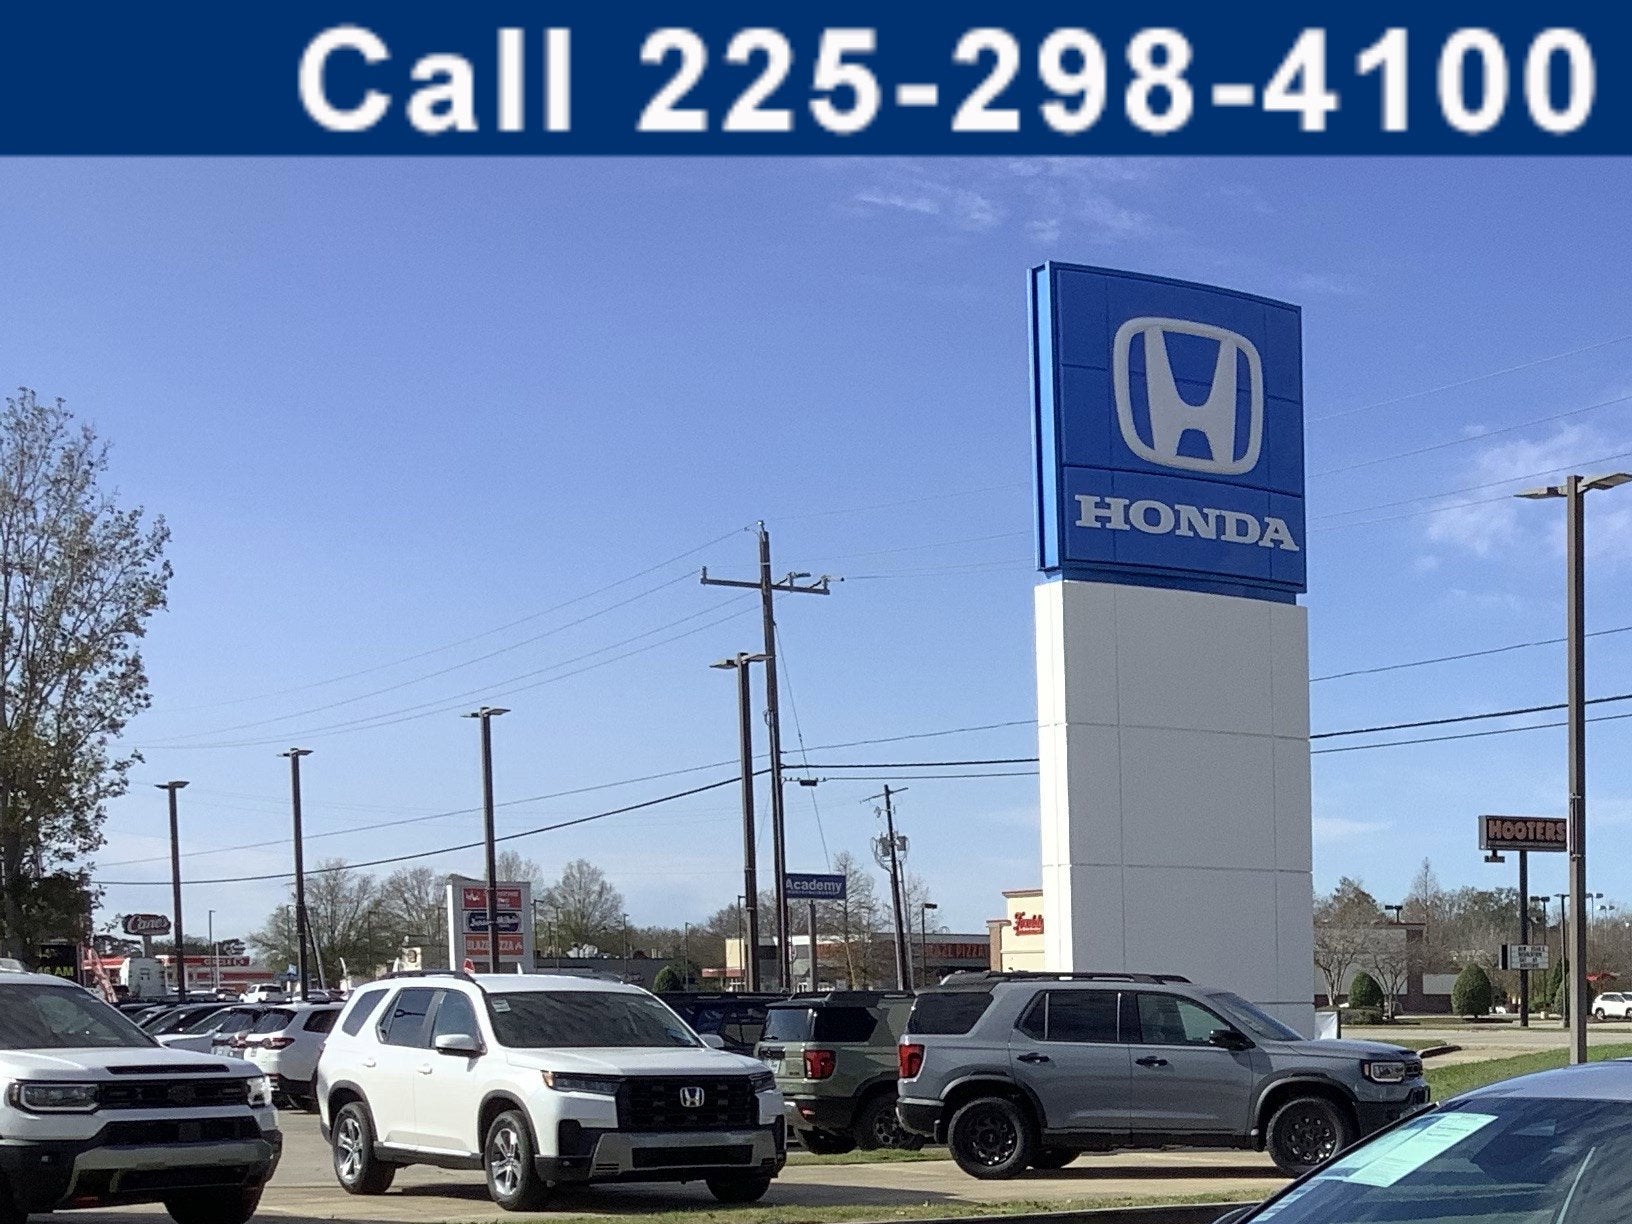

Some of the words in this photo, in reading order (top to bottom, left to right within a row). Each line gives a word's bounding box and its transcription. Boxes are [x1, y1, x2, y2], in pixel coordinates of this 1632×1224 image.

[1074, 494, 1300, 552] HONDA
[1488, 819, 1566, 843] HOOTERS
[786, 878, 843, 894] Academy
